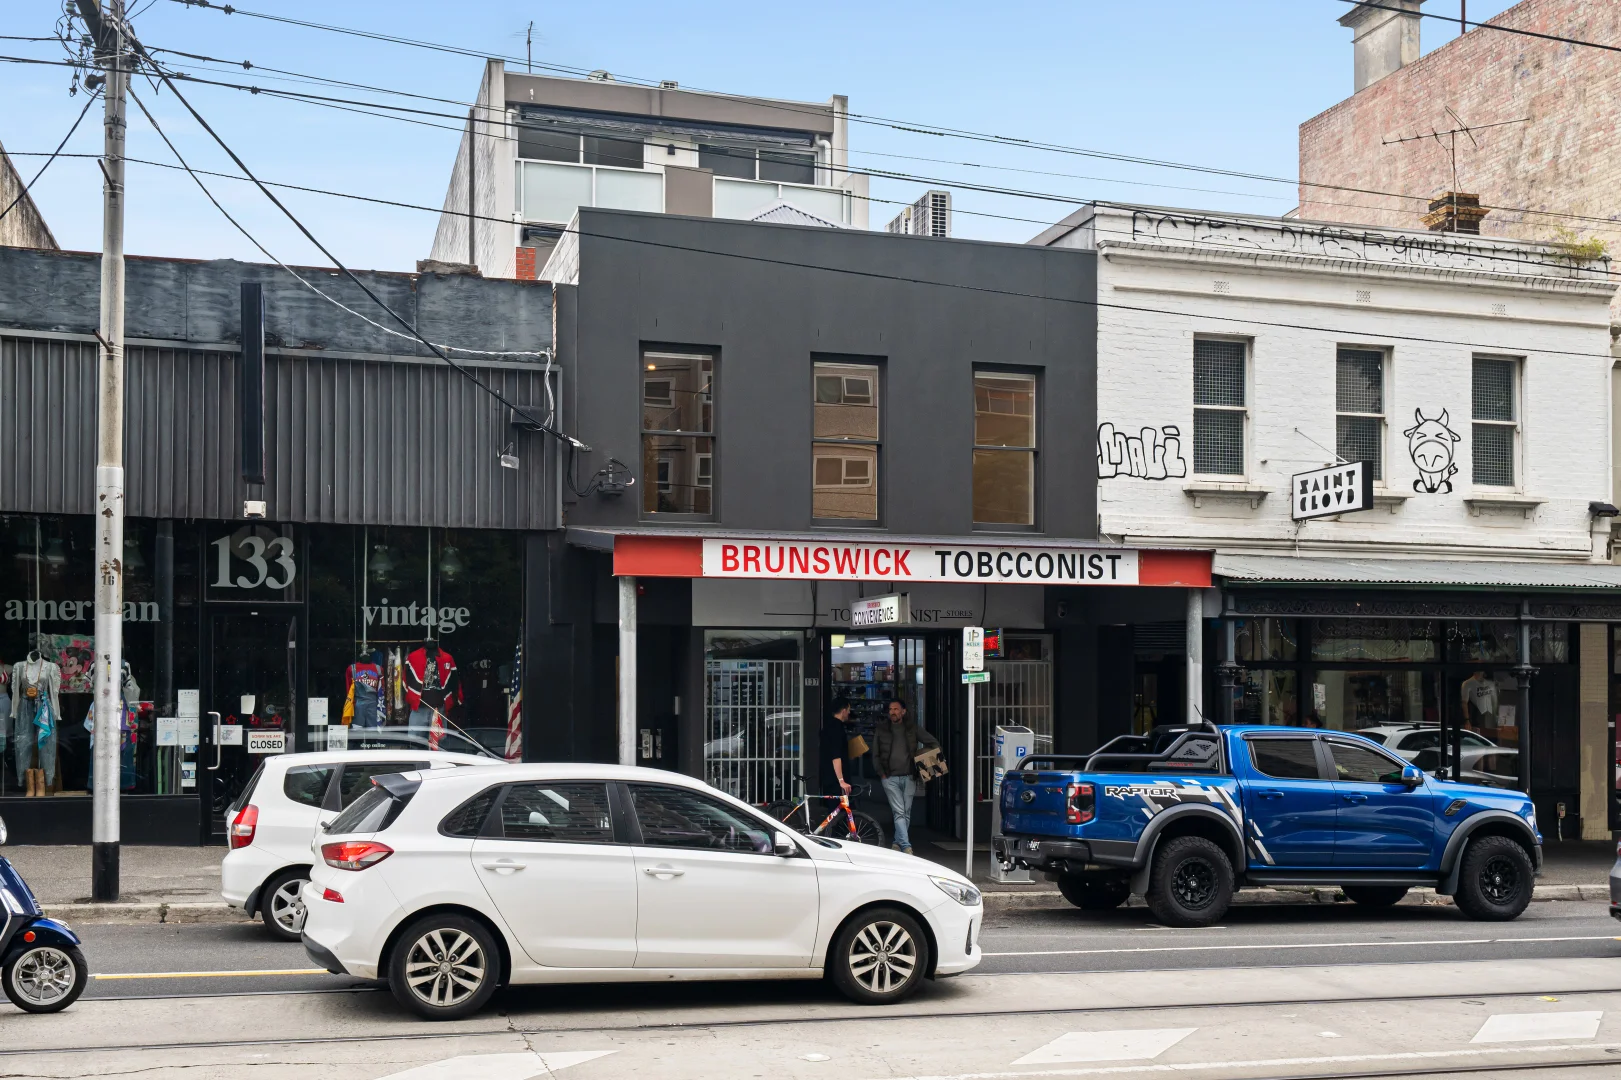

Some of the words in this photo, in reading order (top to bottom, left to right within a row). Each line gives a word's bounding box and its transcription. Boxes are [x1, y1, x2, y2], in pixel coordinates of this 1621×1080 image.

[1299, 469, 1356, 495] SAINT
[210, 535, 297, 590] 133
[721, 544, 912, 576] BRUNSWICK
[934, 550, 1122, 580] TOBCCONIST
[4, 599, 161, 622] ameran
[360, 597, 471, 634] vintage
[853, 606, 894, 625] CONVENIENCE
[250, 740, 283, 749] CLOSED
[1018, 748, 1025, 756] P
[1105, 786, 1181, 802] RAPTOR
